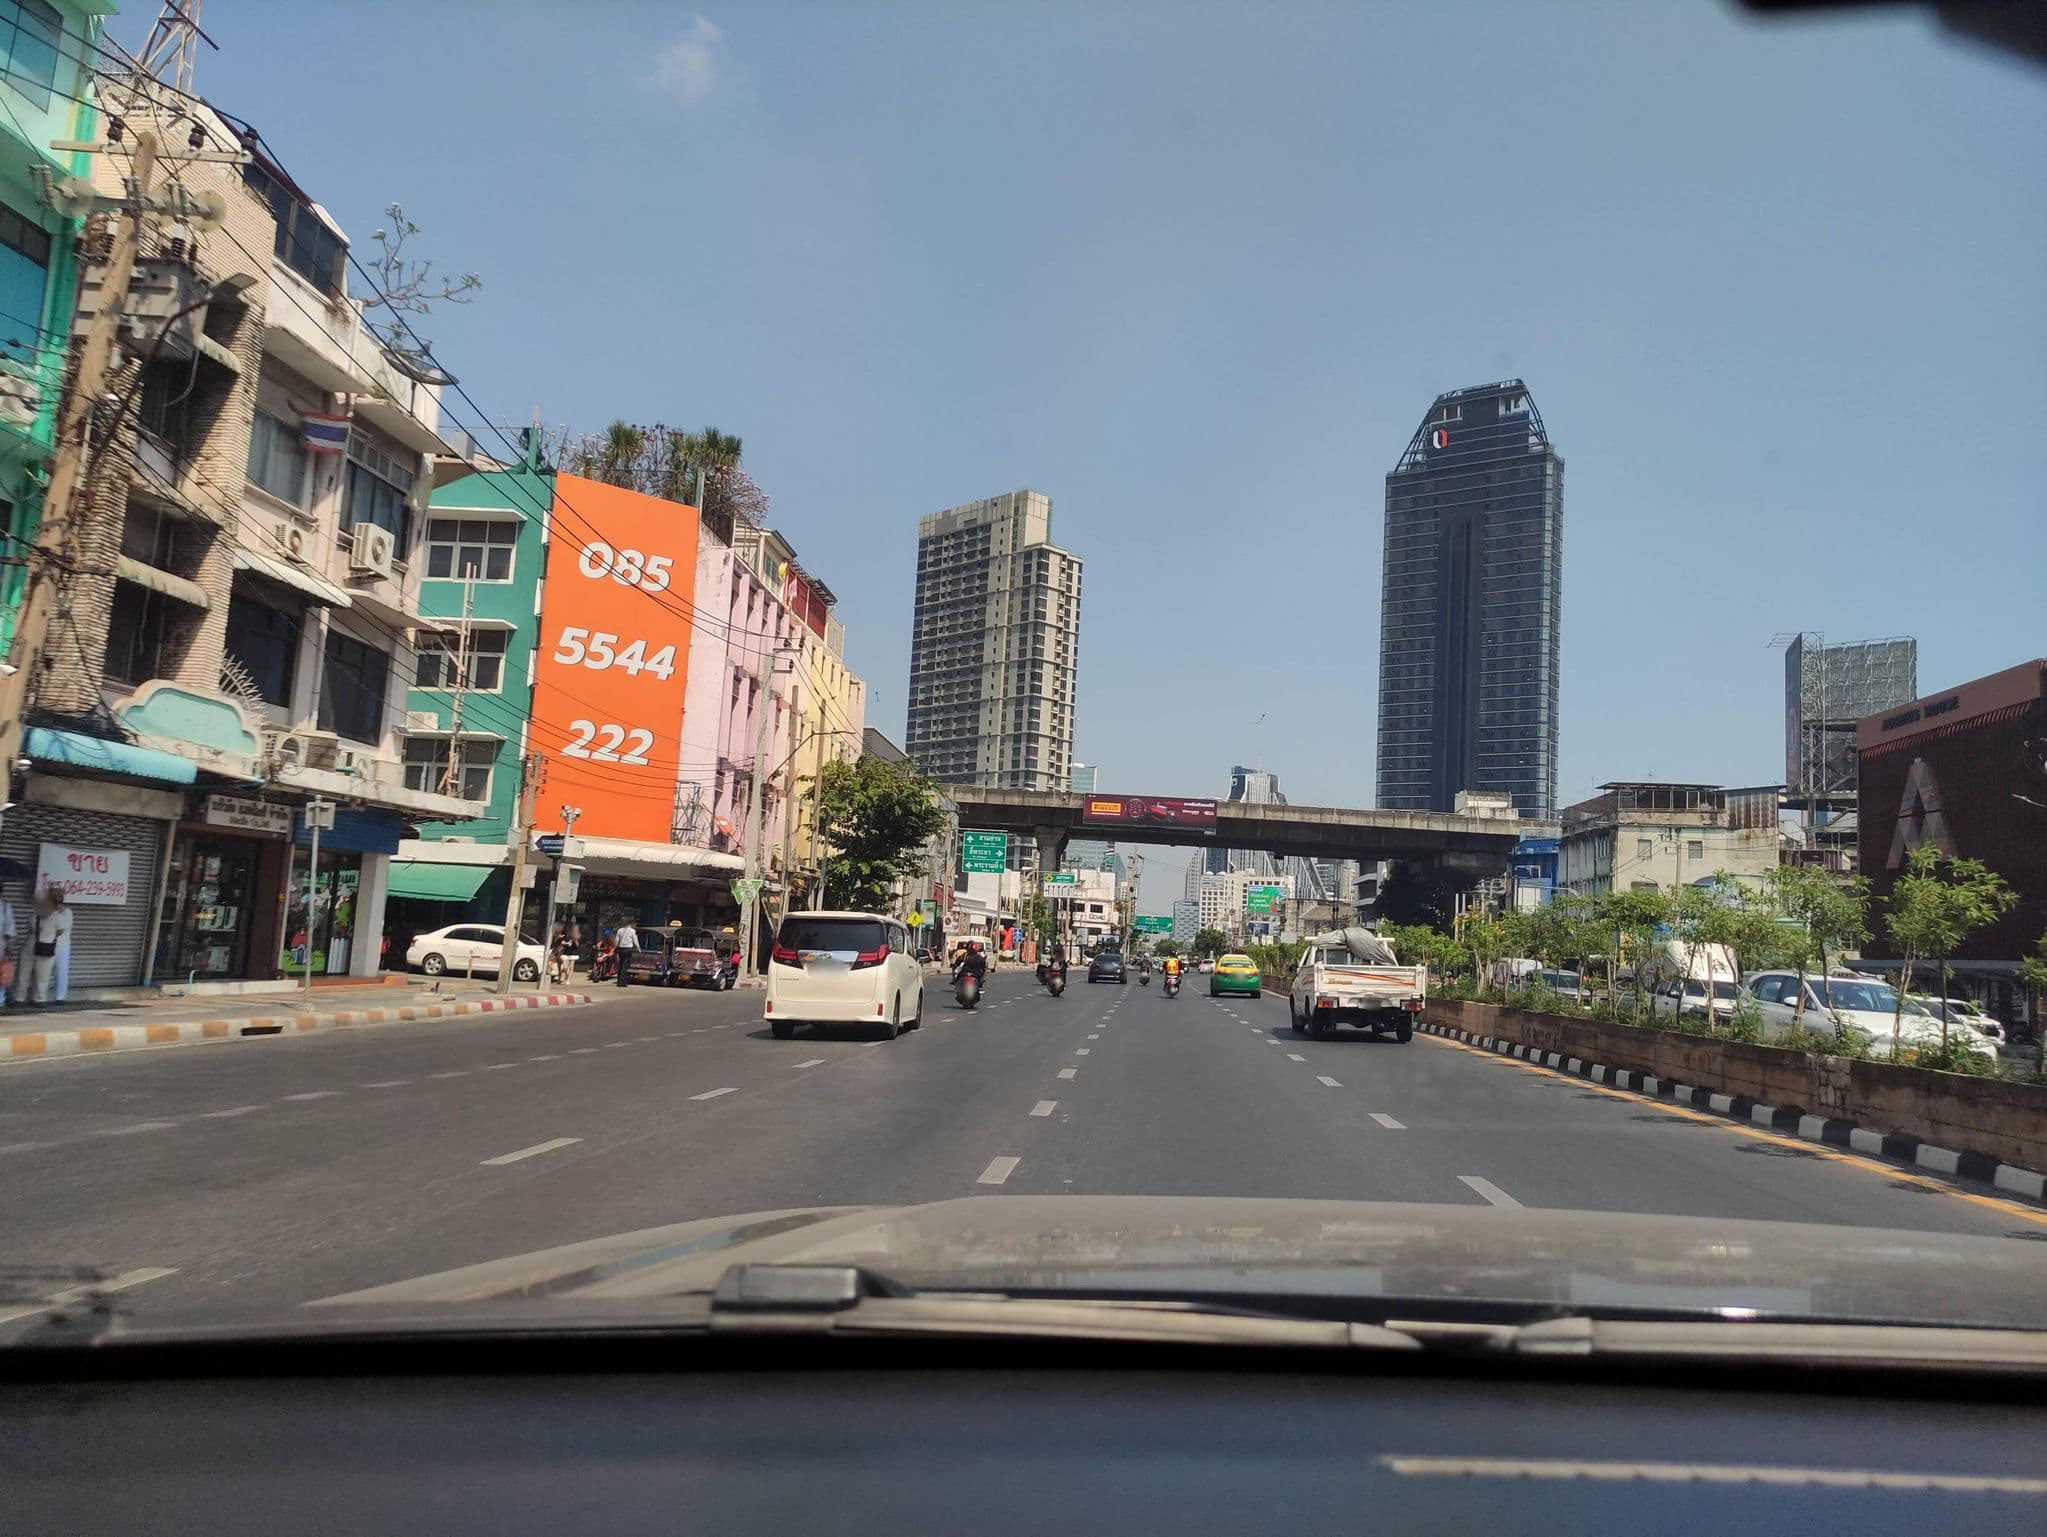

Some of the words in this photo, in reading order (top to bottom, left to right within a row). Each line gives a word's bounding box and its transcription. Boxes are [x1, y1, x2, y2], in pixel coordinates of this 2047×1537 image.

[579, 541, 674, 592] 085
[553, 626, 677, 681] 5544
[561, 719, 655, 766] 222
[67, 853, 108, 873] ขาย
